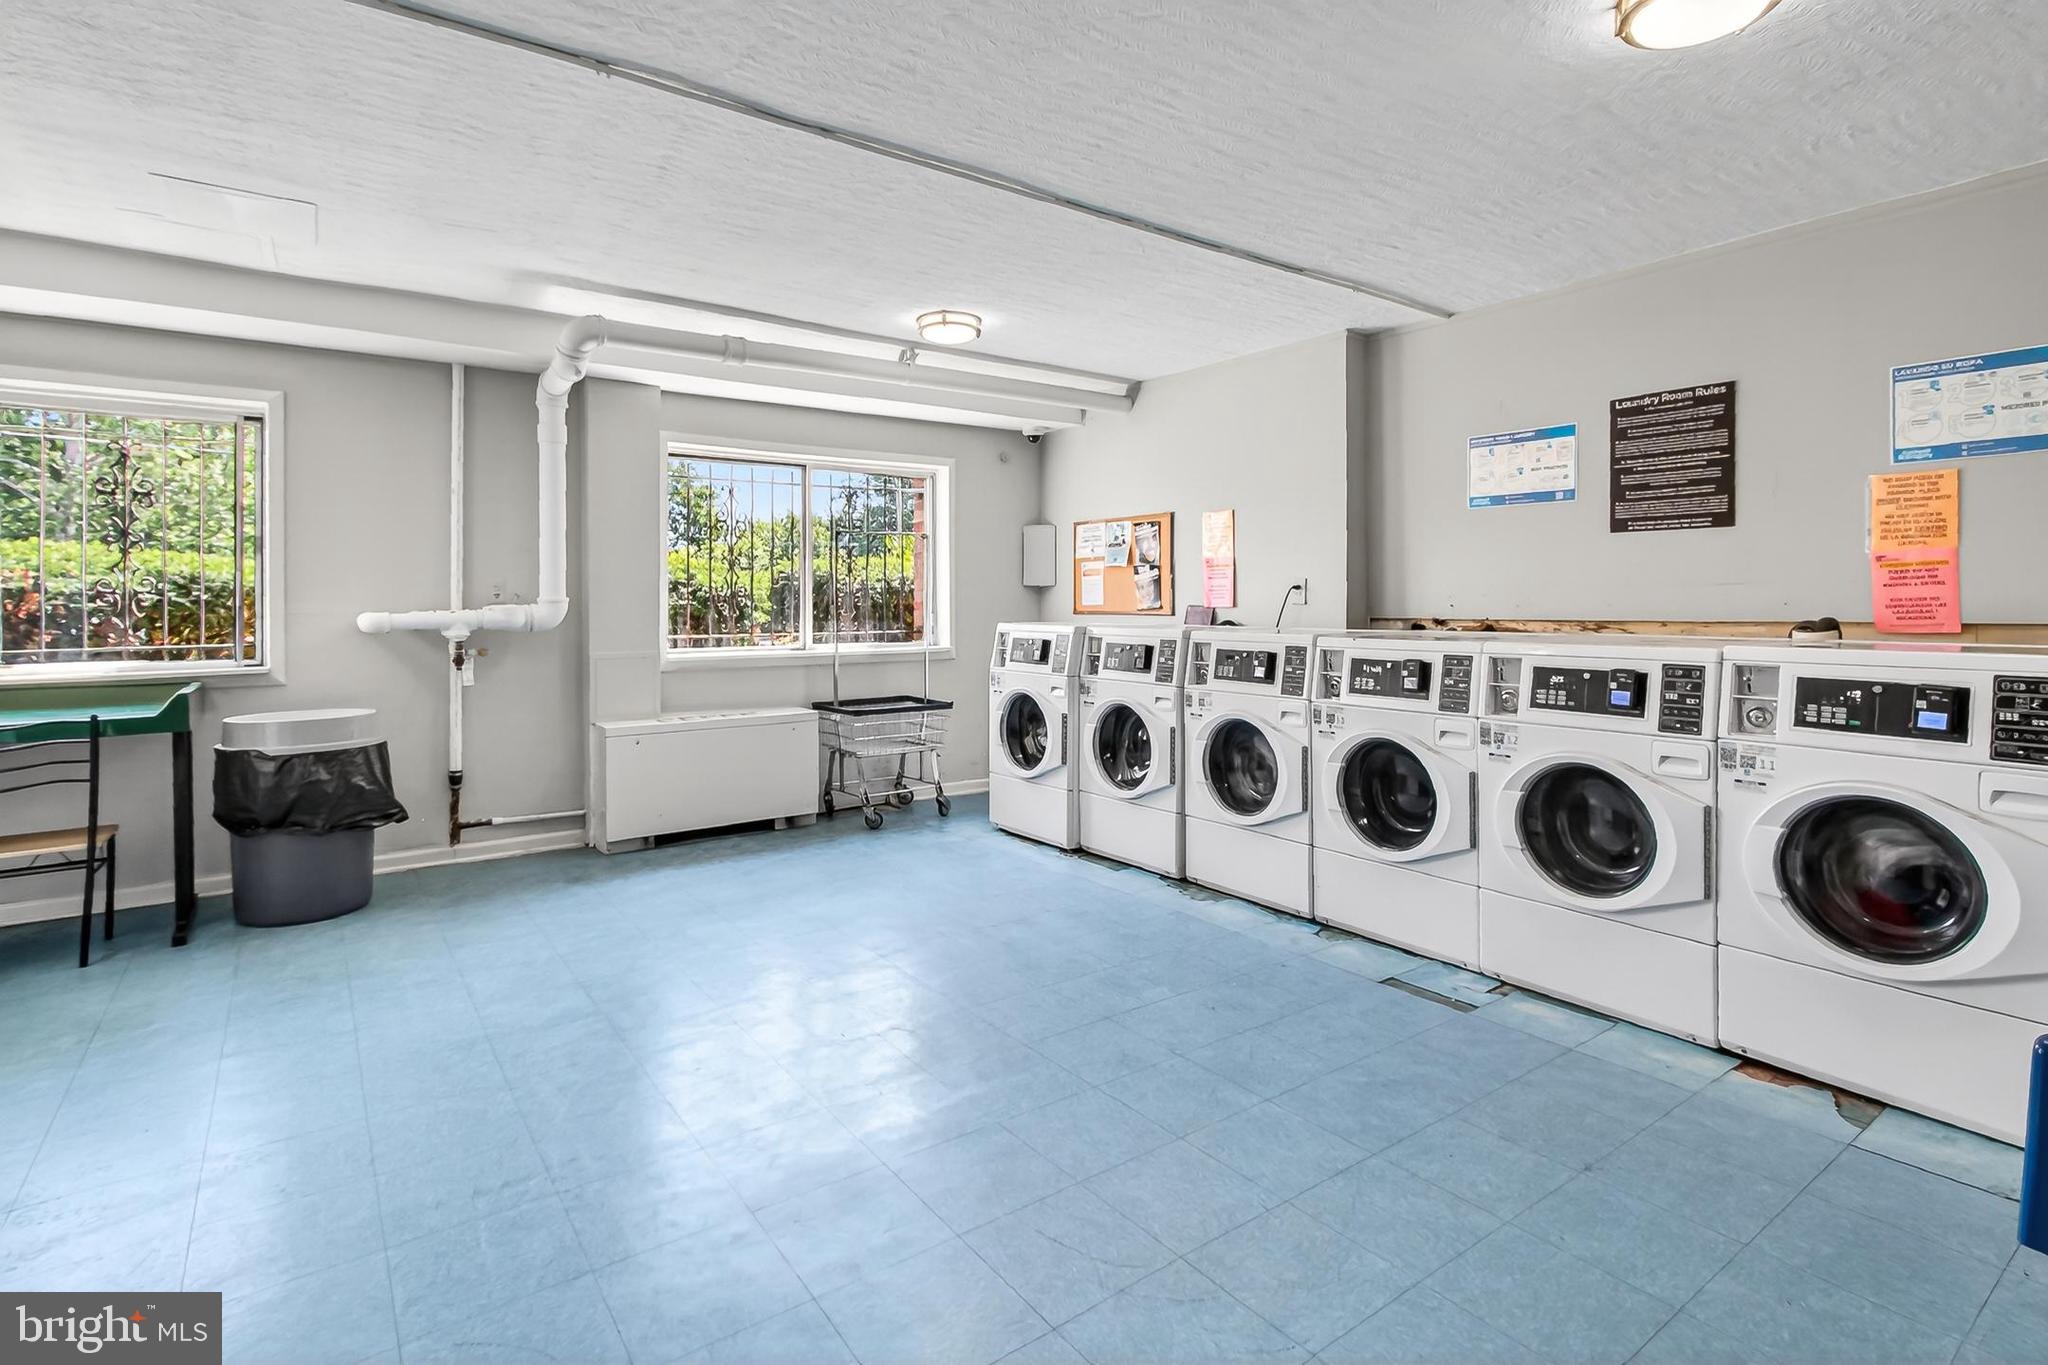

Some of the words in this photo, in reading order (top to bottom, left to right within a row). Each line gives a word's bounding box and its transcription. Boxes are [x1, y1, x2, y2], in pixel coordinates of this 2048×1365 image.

[1615, 396, 1660, 410] Laundry
[1661, 391, 1693, 403] Room
[1695, 384, 1727, 397] Rules
